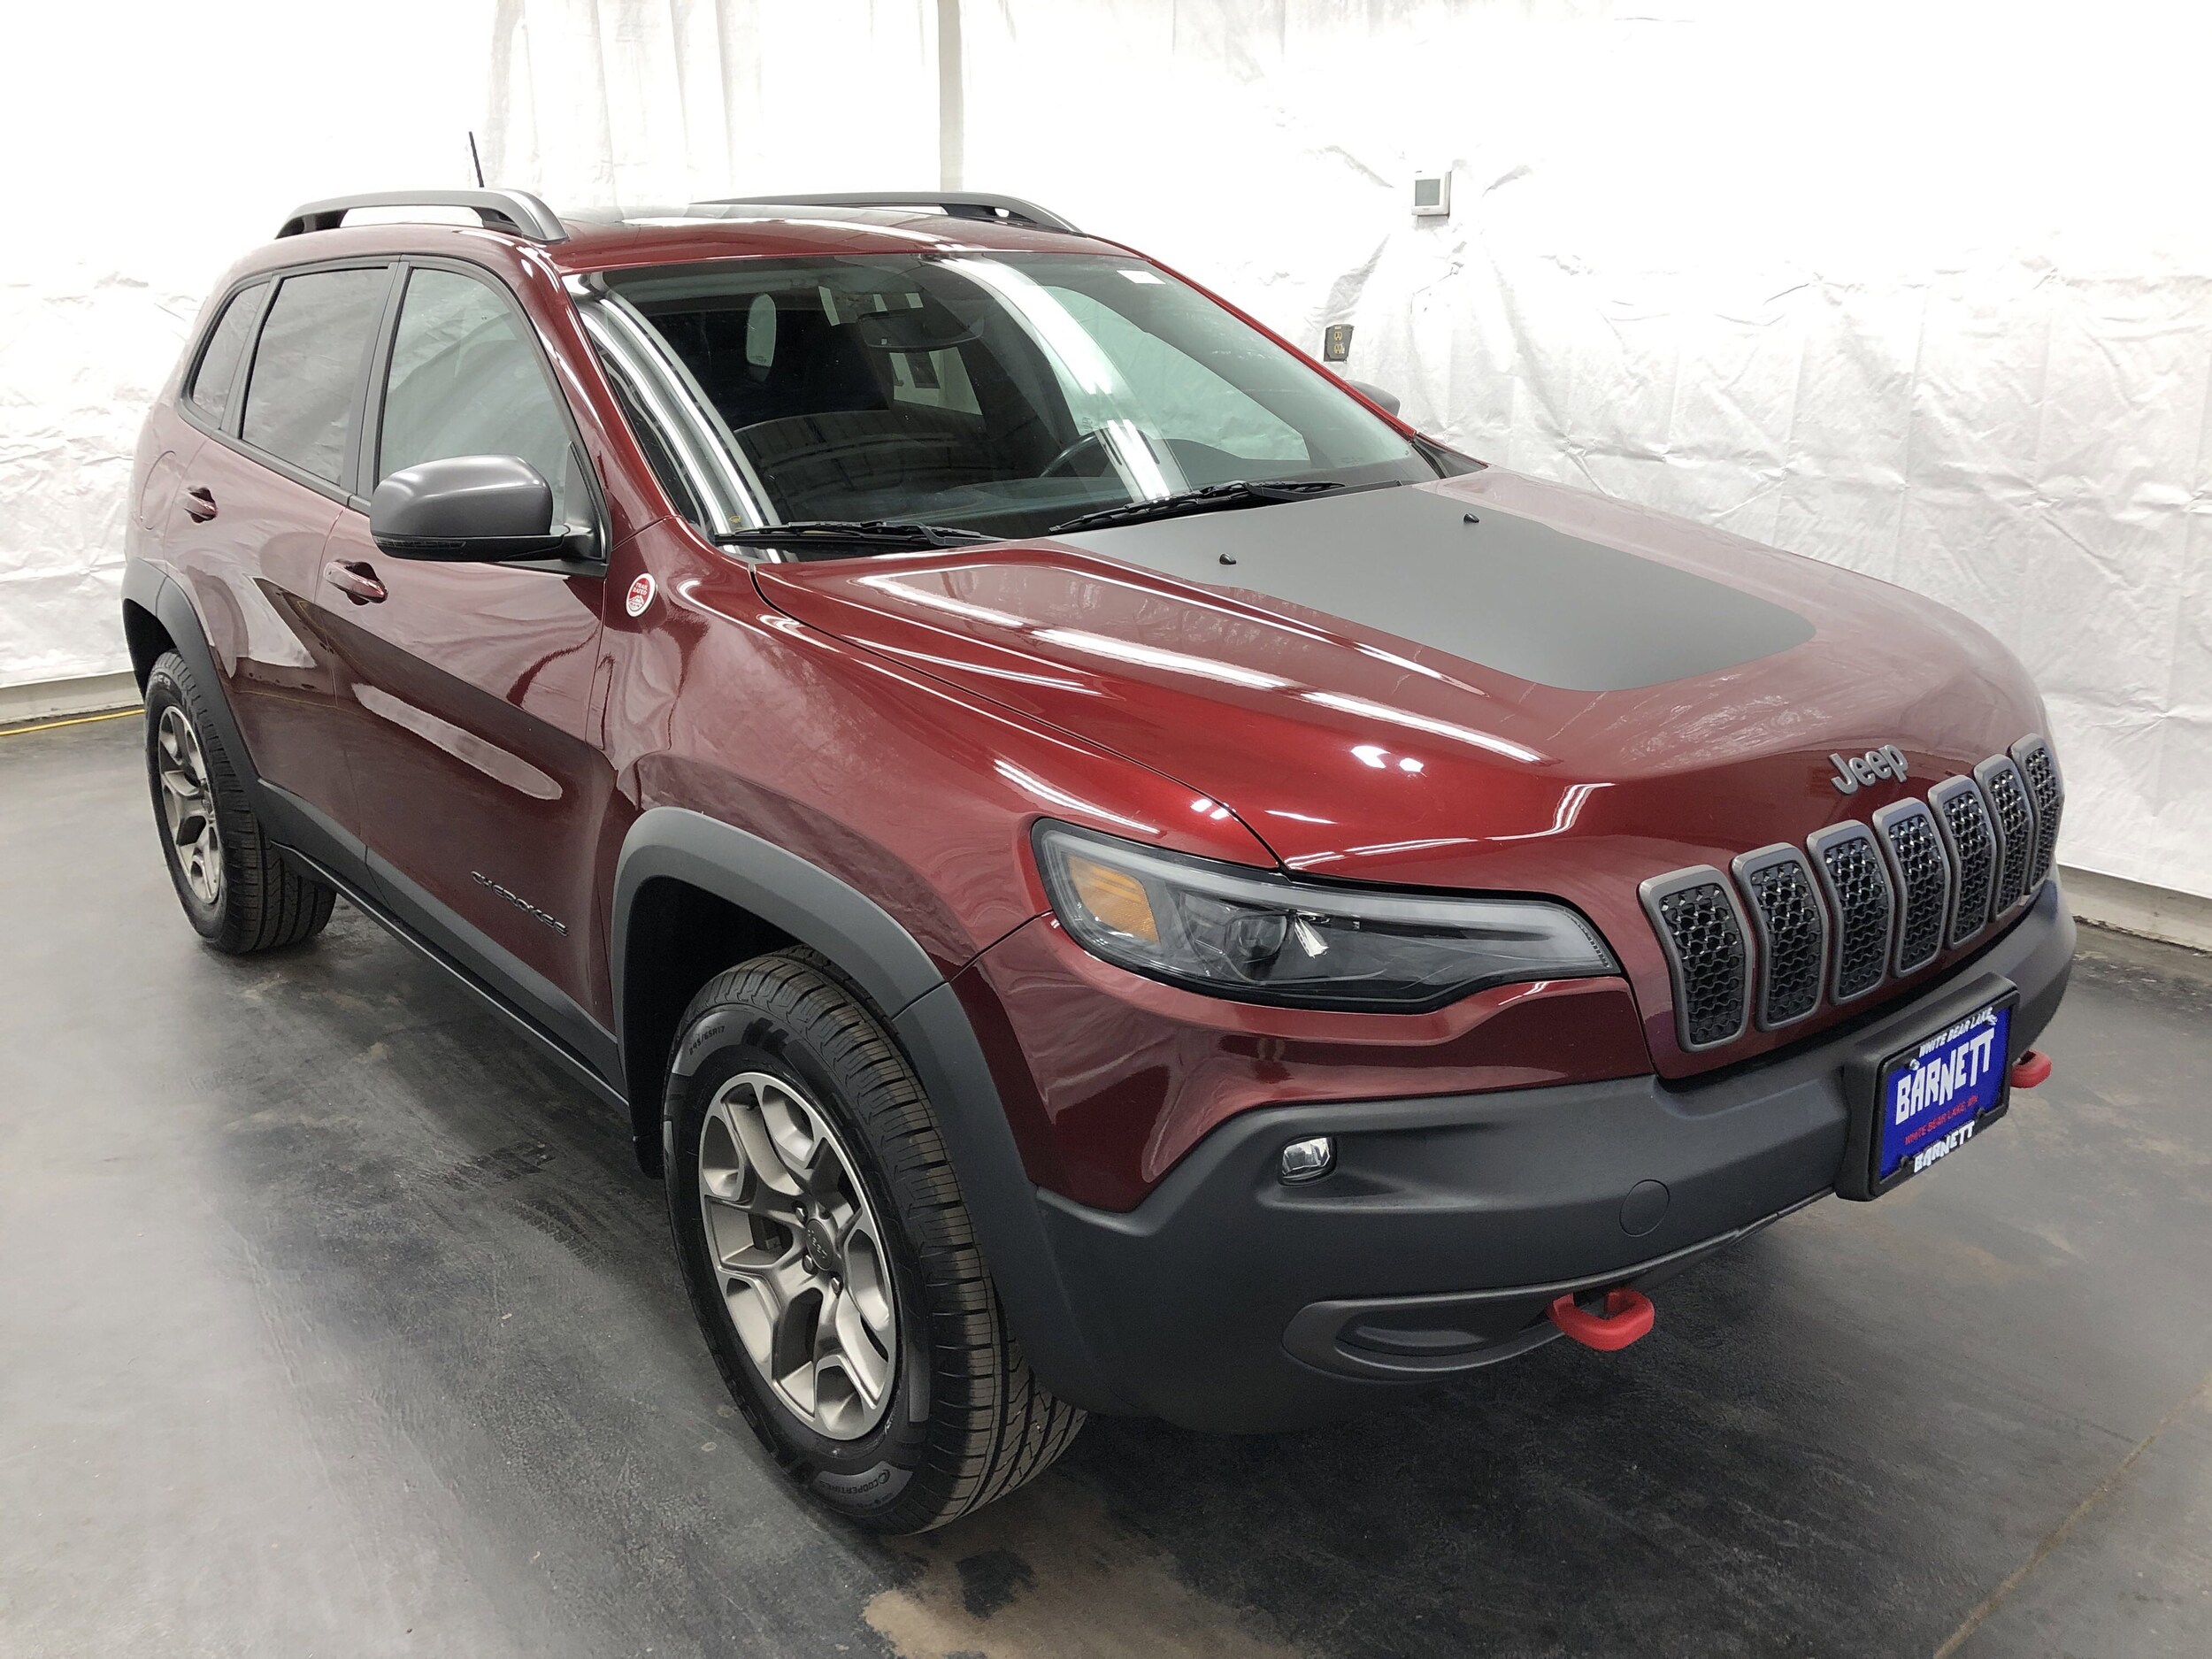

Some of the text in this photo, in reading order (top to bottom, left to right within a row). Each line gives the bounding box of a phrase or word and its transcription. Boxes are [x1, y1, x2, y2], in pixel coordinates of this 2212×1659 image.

[1829, 744, 1909, 794] Jeep
[1919, 1033, 1947, 1058] WHITE
[1947, 1020, 1970, 1042] BEAR
[1895, 1027, 1995, 1125] BARNETT
[1914, 1120, 1976, 1173] BARNETT
